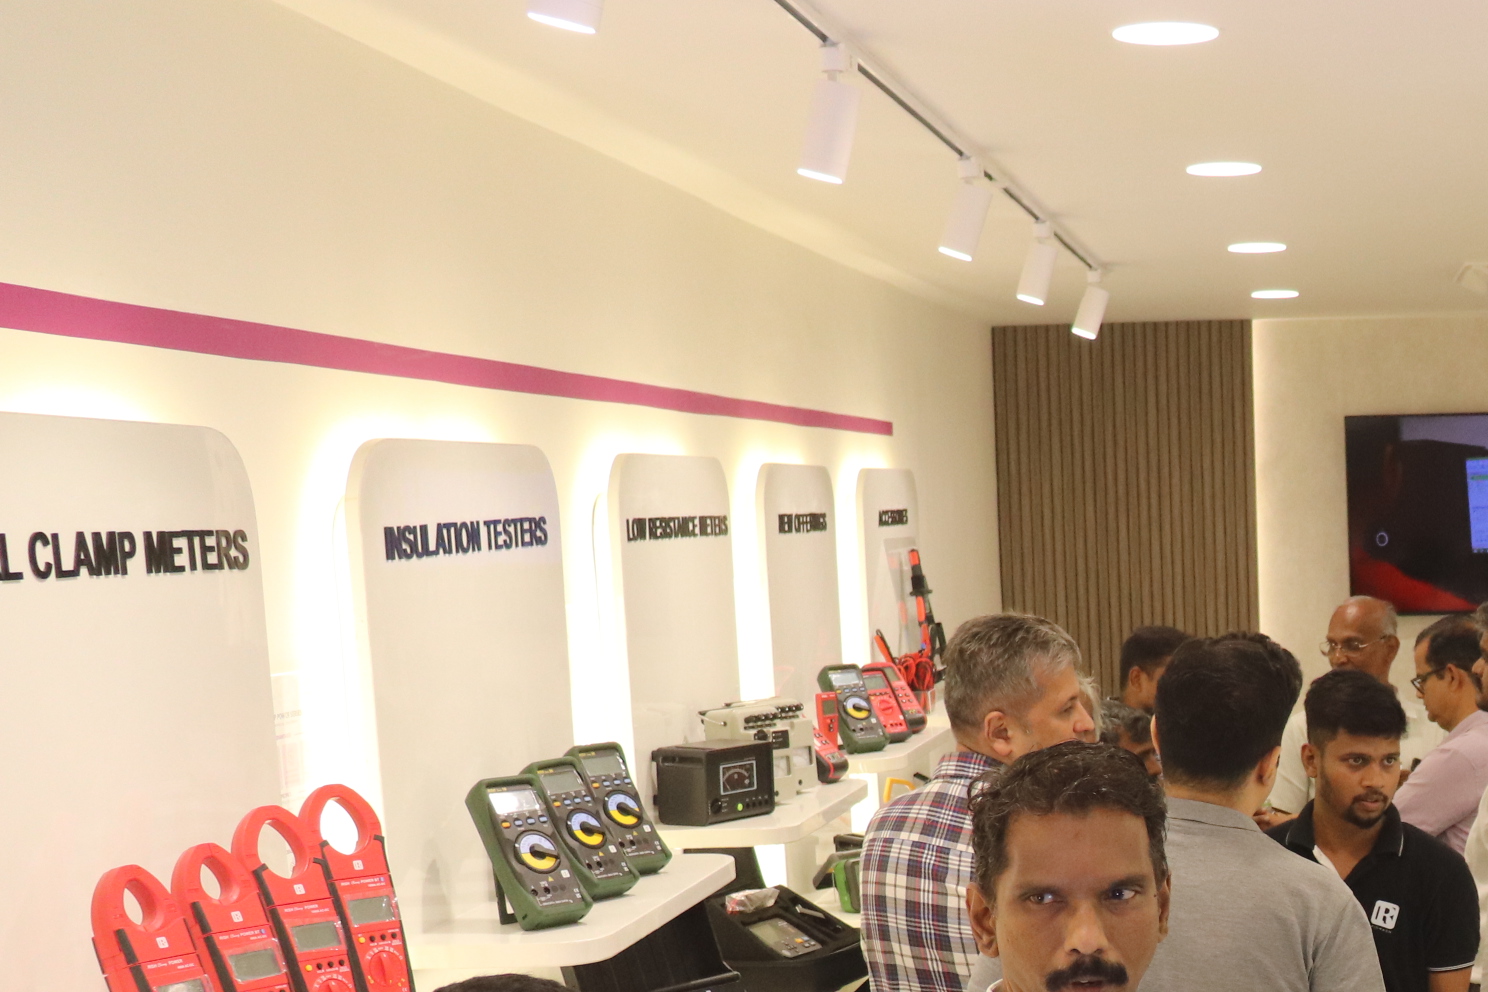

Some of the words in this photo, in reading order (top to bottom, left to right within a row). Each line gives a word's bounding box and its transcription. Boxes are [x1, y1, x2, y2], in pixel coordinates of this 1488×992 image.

[384, 519, 482, 561] INSULATION
[483, 516, 549, 551] TESTERS
[626, 517, 647, 542] LOW
[648, 516, 698, 540] RESISTANCE
[698, 515, 728, 537] METERS
[28, 531, 137, 580] CLAMP
[143, 529, 250, 575] METERS
